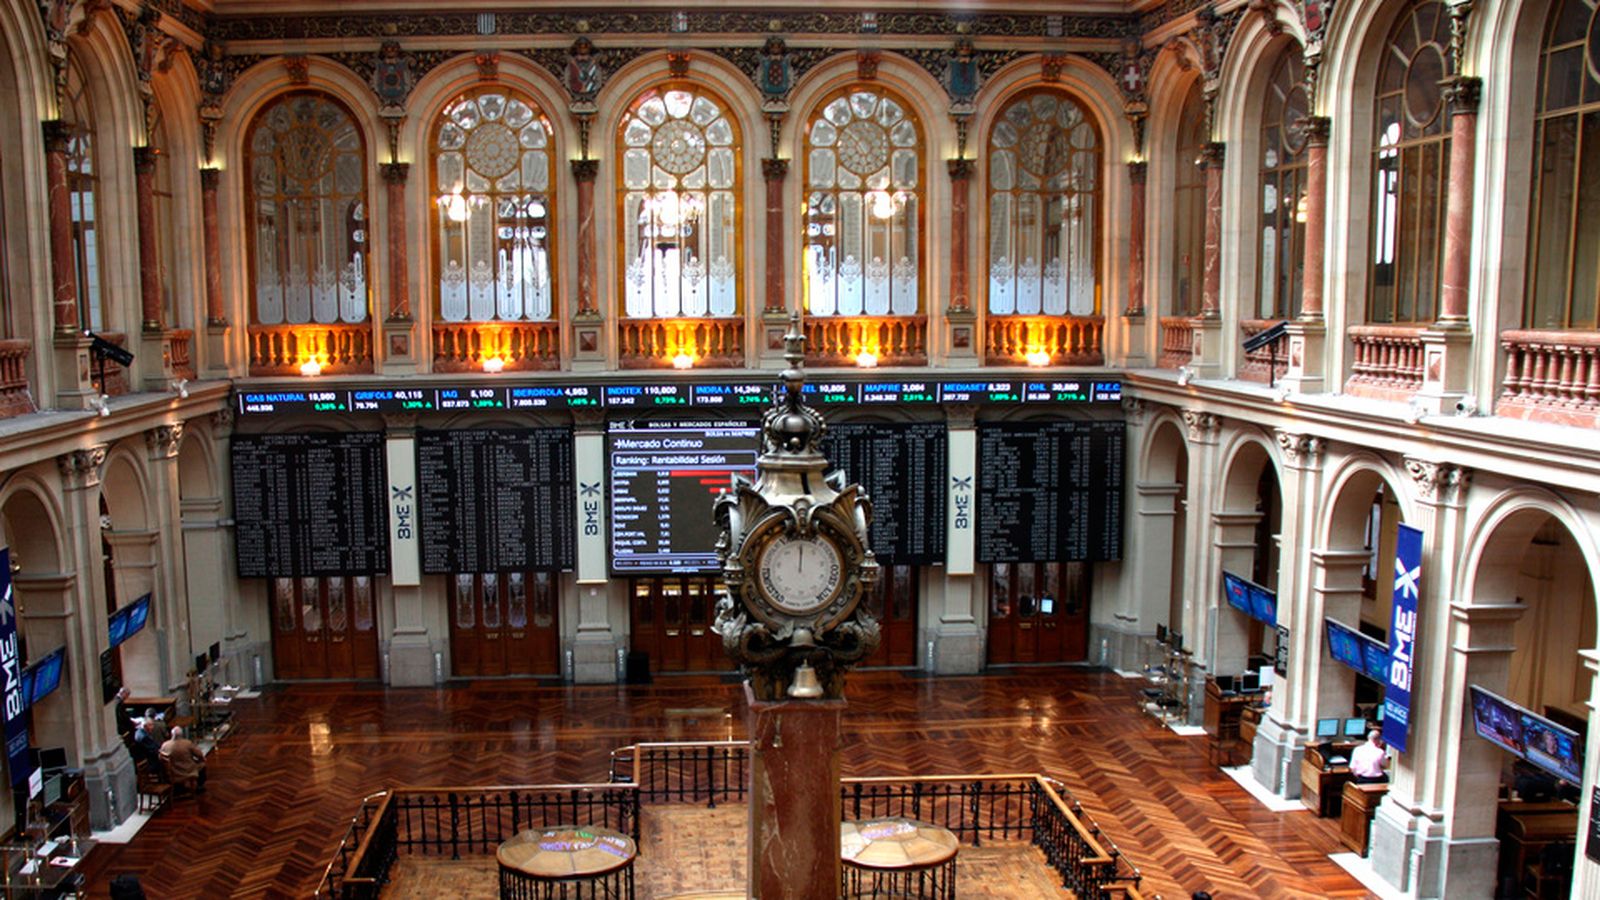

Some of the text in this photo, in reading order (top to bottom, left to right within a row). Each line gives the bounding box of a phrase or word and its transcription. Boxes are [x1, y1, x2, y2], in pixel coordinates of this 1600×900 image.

[607, 386, 643, 396] INDITEX
[695, 386, 723, 395] INDRA
[864, 384, 900, 393] MAPFRE
[943, 383, 987, 392] MEDIASET
[246, 394, 265, 403] GAS
[266, 393, 306, 402] NATURAL
[354, 391, 393, 401] GRIFOLS
[512, 388, 563, 398] IBERDROLA
[679, 420, 712, 428] MERCADOS
[713, 419, 748, 427] ESPAÑOLES
[620, 438, 704, 449] Mercado Continuo
[615, 454, 726, 466] Ranking: Rentabilidad Sesión
[955, 495, 968, 529] BME
[396, 504, 411, 540] BME
[584, 500, 598, 536] BME
[1390, 604, 1414, 692] BME
[0, 632, 21, 721] BME
